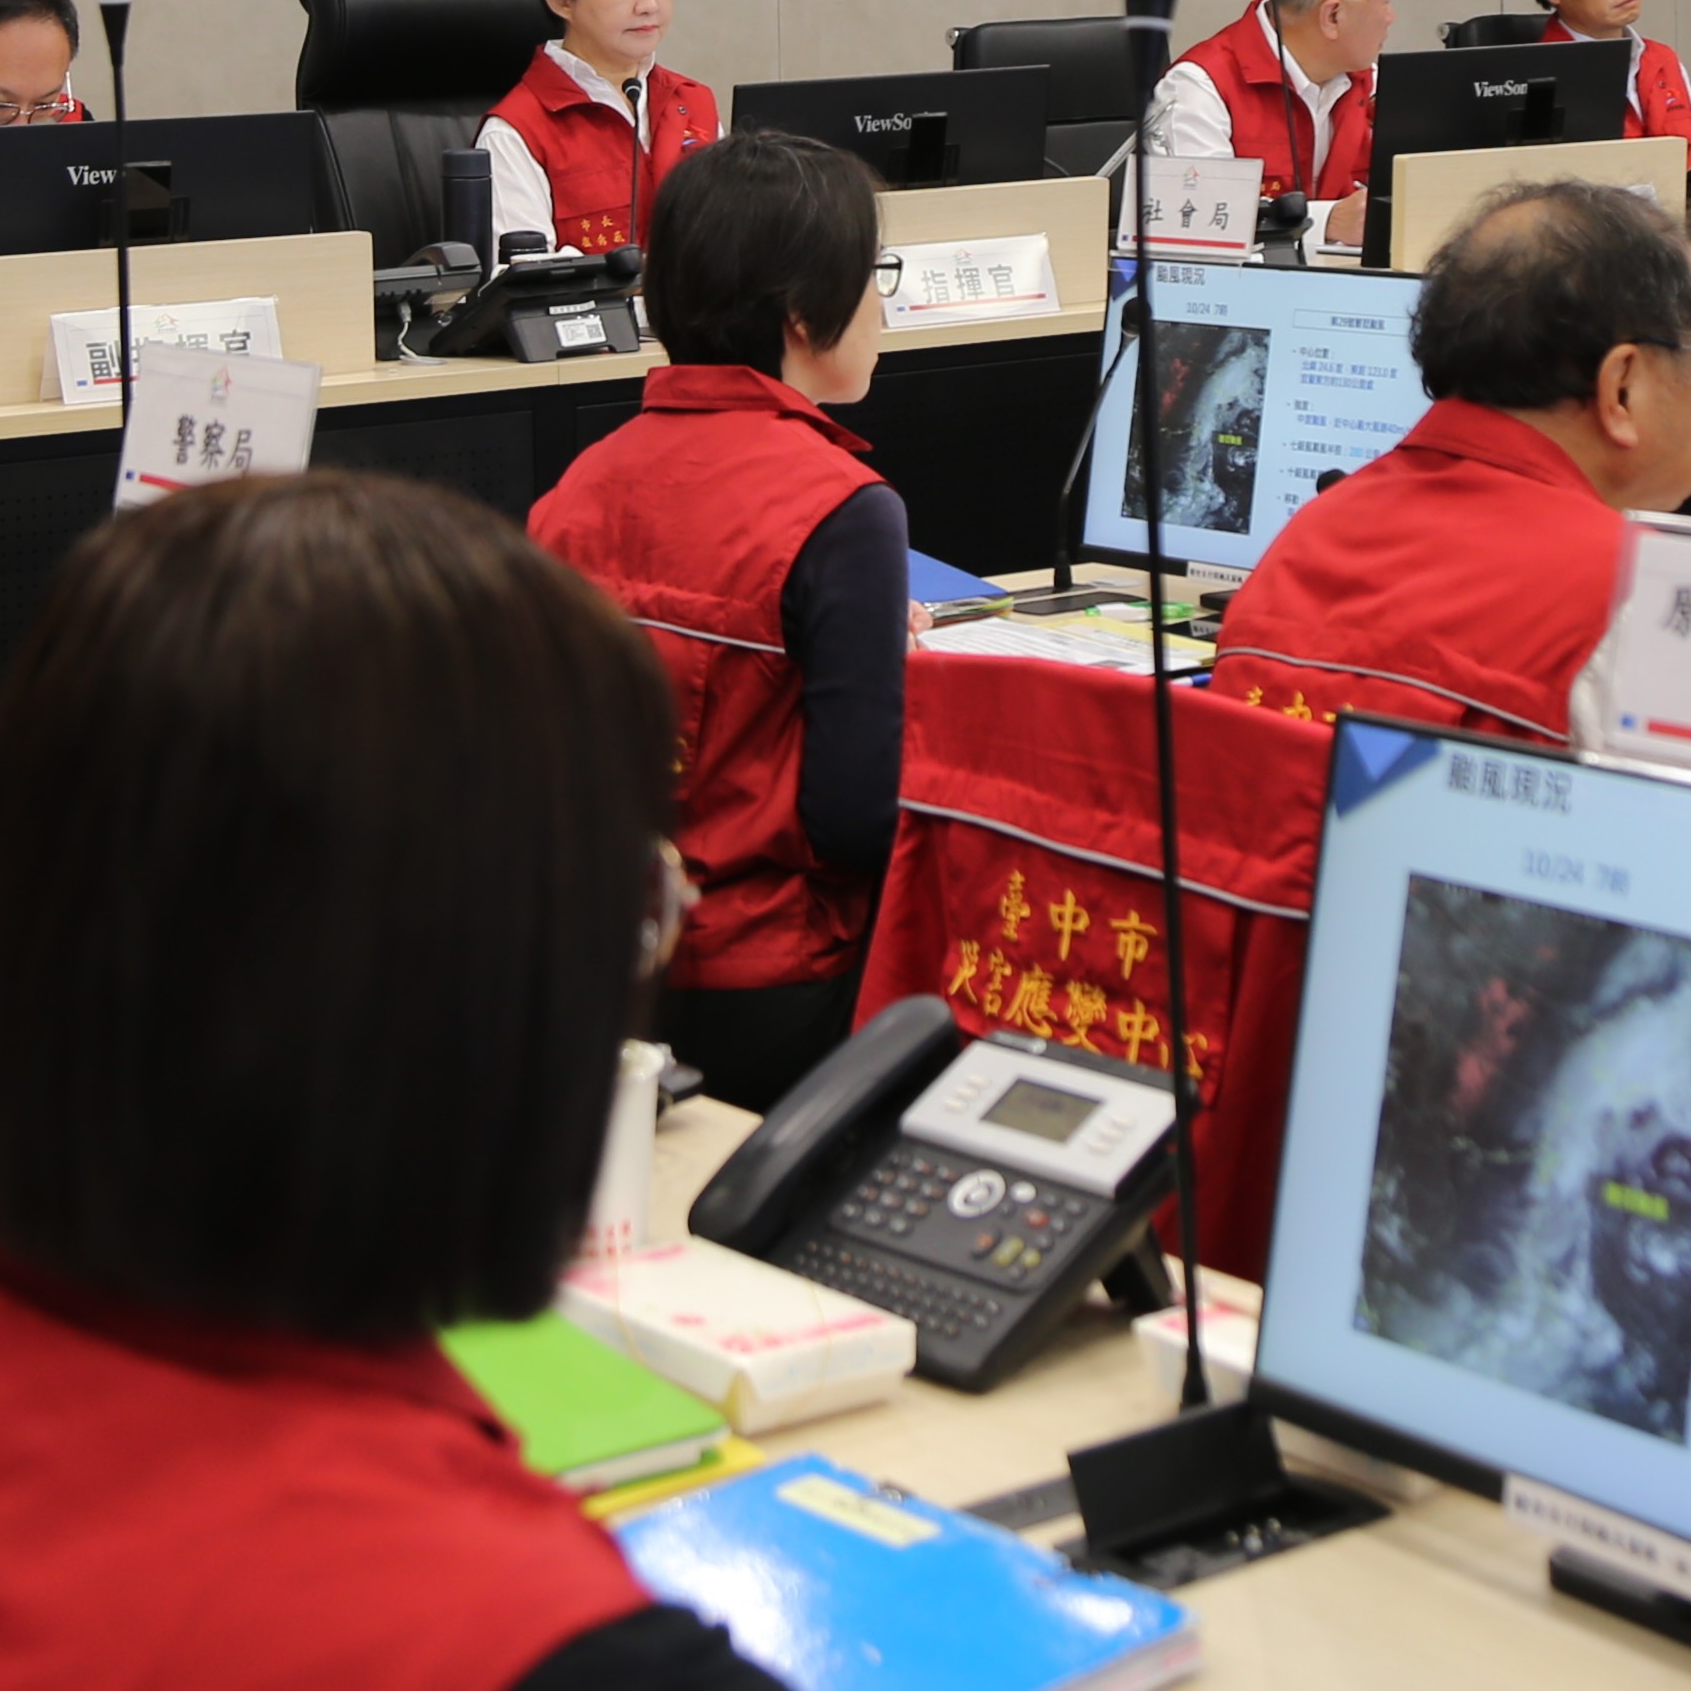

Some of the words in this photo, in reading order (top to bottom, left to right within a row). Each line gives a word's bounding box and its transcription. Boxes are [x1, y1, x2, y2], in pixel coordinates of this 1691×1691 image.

[1473, 79, 1528, 97] ViewSon
[854, 112, 913, 133] ViewSo
[1140, 197, 1230, 231] 社會局
[921, 263, 1015, 304] 指揮官
[173, 413, 253, 476] 警察局
[999, 868, 1158, 981] 臺中市
[947, 938, 1209, 1079] 災害應變中心
